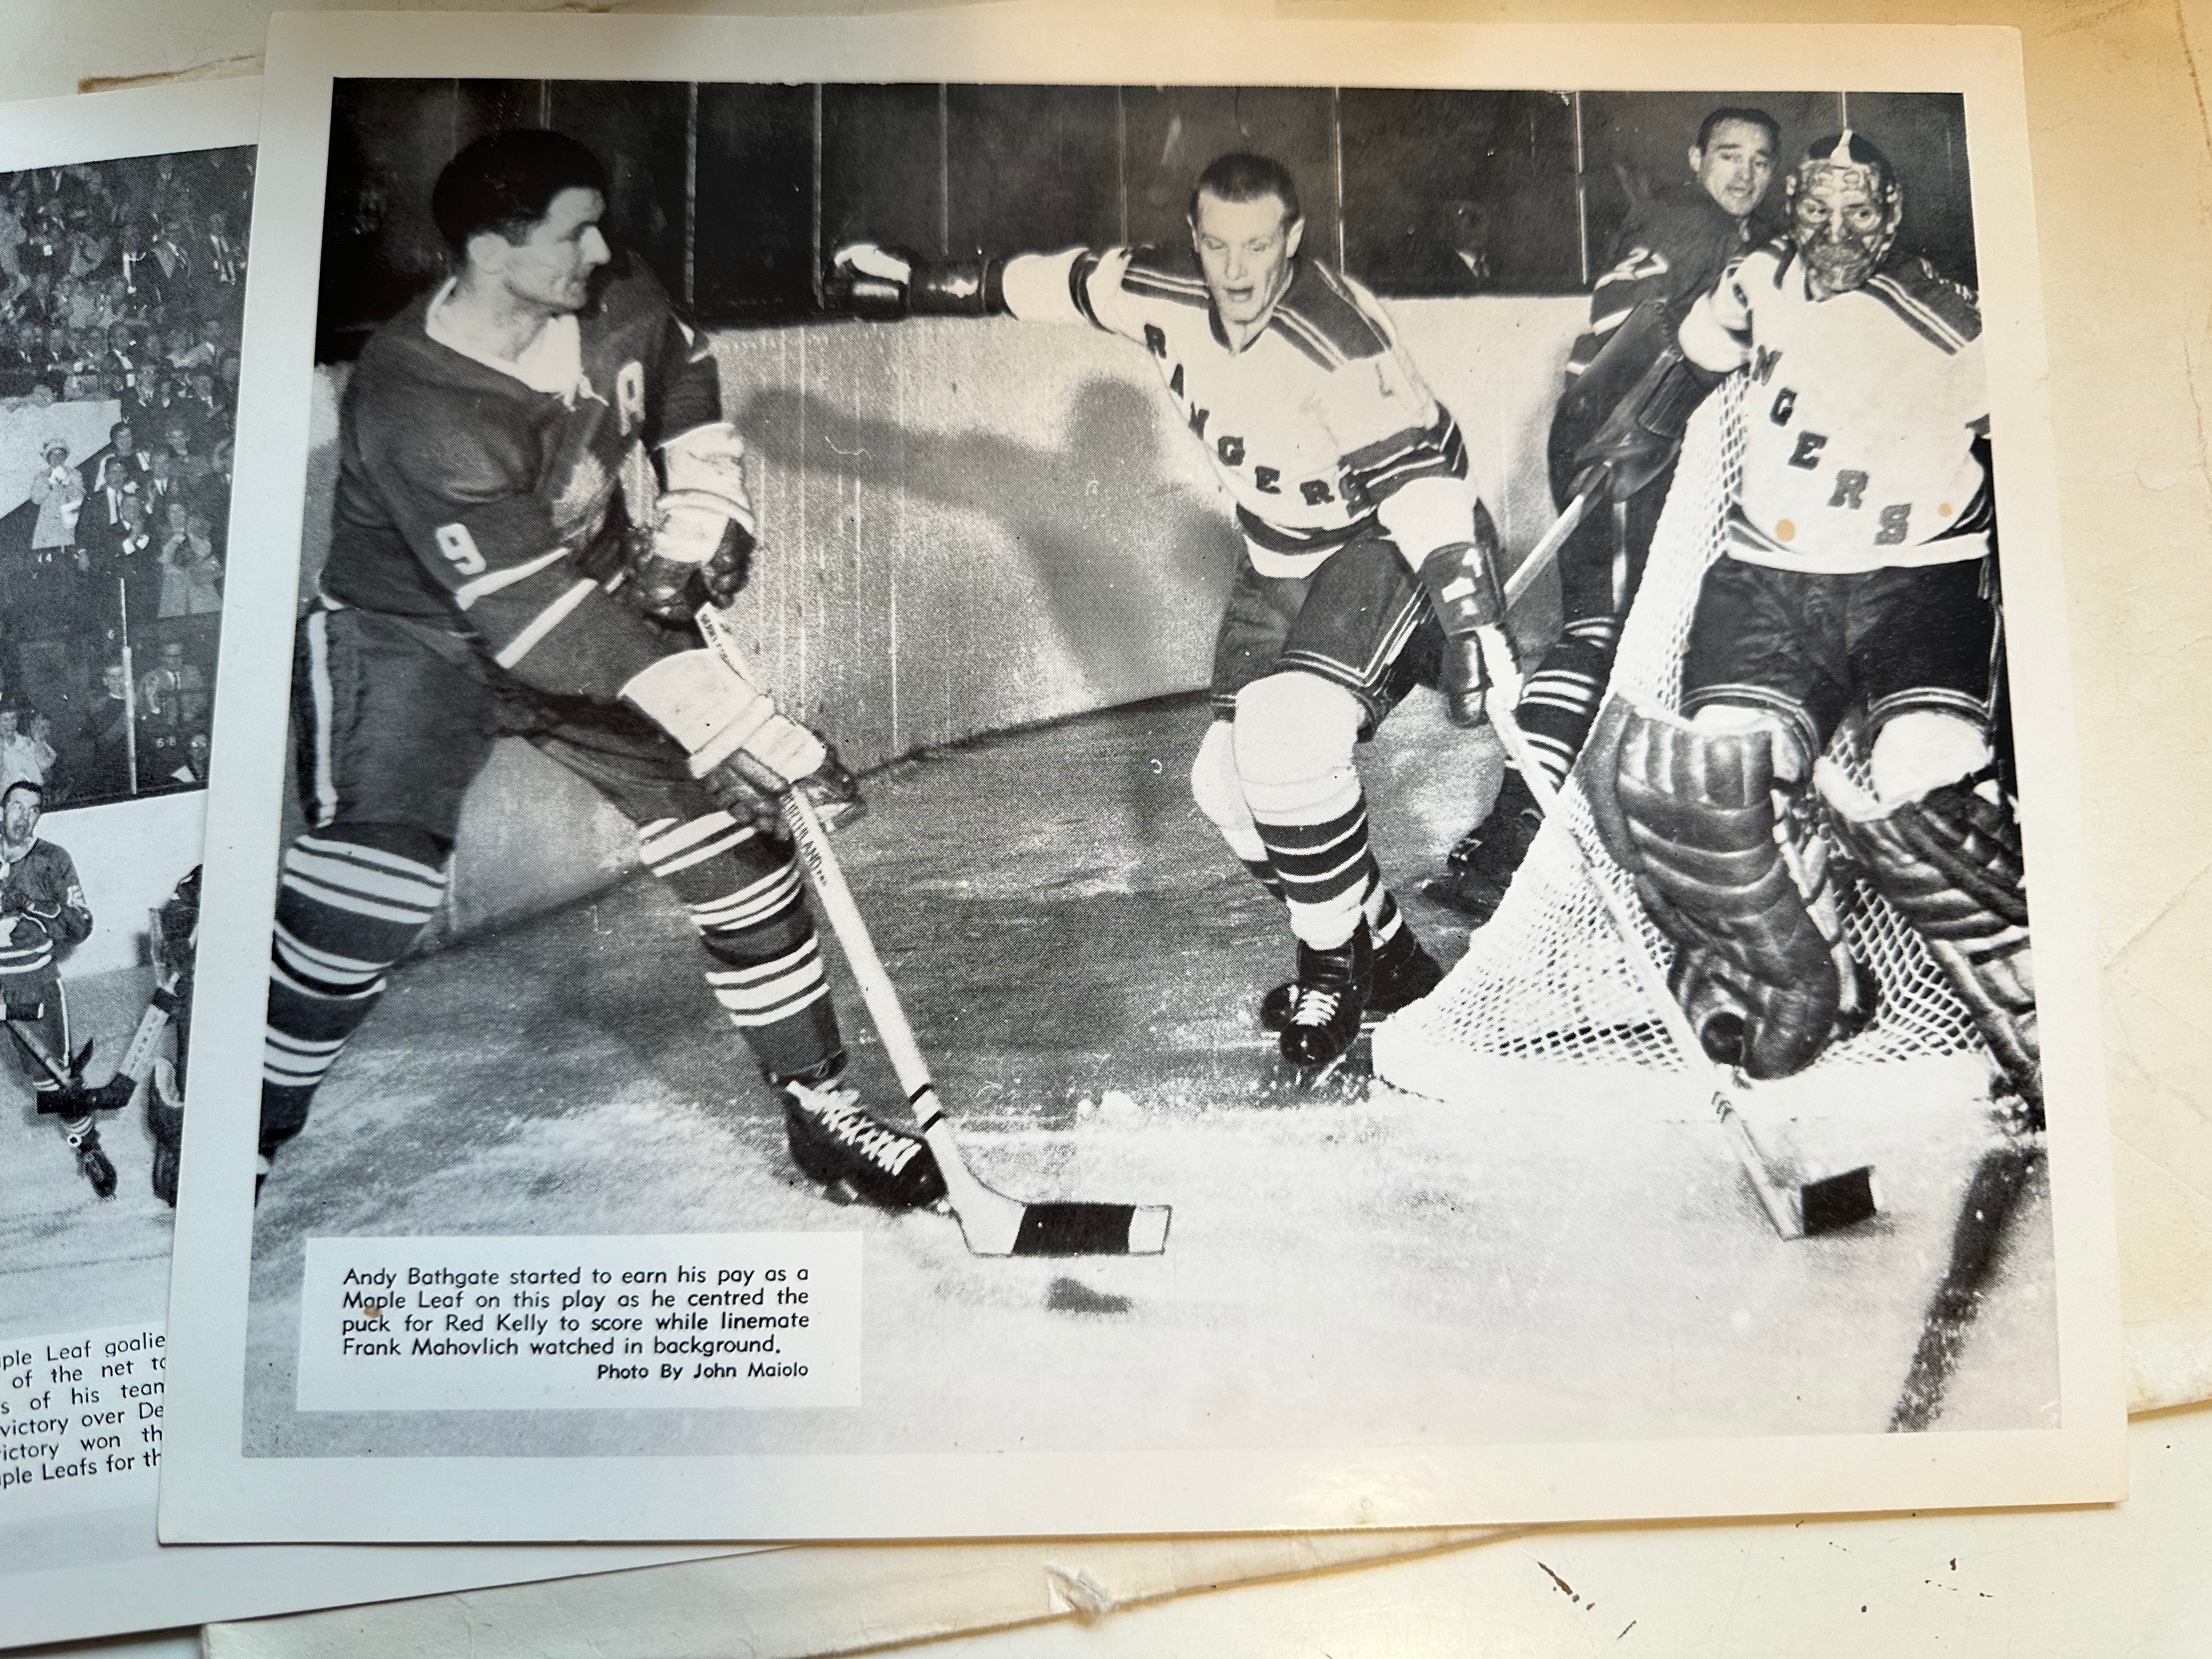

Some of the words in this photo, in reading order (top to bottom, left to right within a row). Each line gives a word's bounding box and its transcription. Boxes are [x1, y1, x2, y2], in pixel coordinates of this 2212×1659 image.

[1752, 345, 1912, 545] NGERS
[437, 523, 487, 575] 9
[343, 1268, 396, 1289] Andy
[409, 1268, 498, 1288] Bathgate
[511, 1267, 580, 1284] started
[592, 1269, 611, 1284] to
[622, 1272, 666, 1283] earn
[679, 1266, 706, 1283] his
[718, 1270, 754, 1286] pay
[765, 1270, 786, 1281] as
[798, 1269, 808, 1280] a
[343, 1291, 405, 1313] Maple
[419, 1291, 462, 1308] Leaf
[476, 1296, 499, 1307] on
[514, 1291, 549, 1308] this
[562, 1290, 605, 1312] play
[618, 1295, 639, 1307] as
[652, 1290, 674, 1307] he
[688, 1288, 763, 1306] centred
[778, 1287, 808, 1304] the
[343, 1315, 390, 1335] puck
[405, 1314, 432, 1331] for
[447, 1314, 483, 1331] Red
[497, 1314, 548, 1335] Kelly
[560, 1317, 579, 1331] to
[592, 1319, 642, 1331] score
[656, 1313, 708, 1330] while
[722, 1312, 809, 1329] linemate
[0, 1350, 32, 1370] ple
[47, 1340, 92, 1361] Leaf
[105, 1332, 166, 1358] goalie
[344, 1338, 400, 1355] Frank
[412, 1338, 518, 1355] Mahovlich
[531, 1338, 613, 1355] watched
[625, 1337, 642, 1353] in
[654, 1335, 780, 1357] background.
[13, 1369, 32, 1388] of
[51, 1365, 83, 1383] the
[101, 1361, 134, 1378] net
[598, 1364, 648, 1379] Photo
[661, 1364, 682, 1380] By
[694, 1363, 736, 1378] John
[748, 1363, 808, 1377] Maiolo
[30, 1391, 50, 1410] of
[72, 1387, 100, 1404] his
[0, 1418, 69, 1437] victory
[82, 1410, 125, 1427] over
[139, 1402, 163, 1419] De
[0, 1443, 59, 1461] ictory
[81, 1435, 121, 1451] won
[142, 1424, 162, 1442] th
[0, 1466, 32, 1489] ple
[42, 1458, 98, 1480] Leafs
[106, 1454, 135, 1472] for
